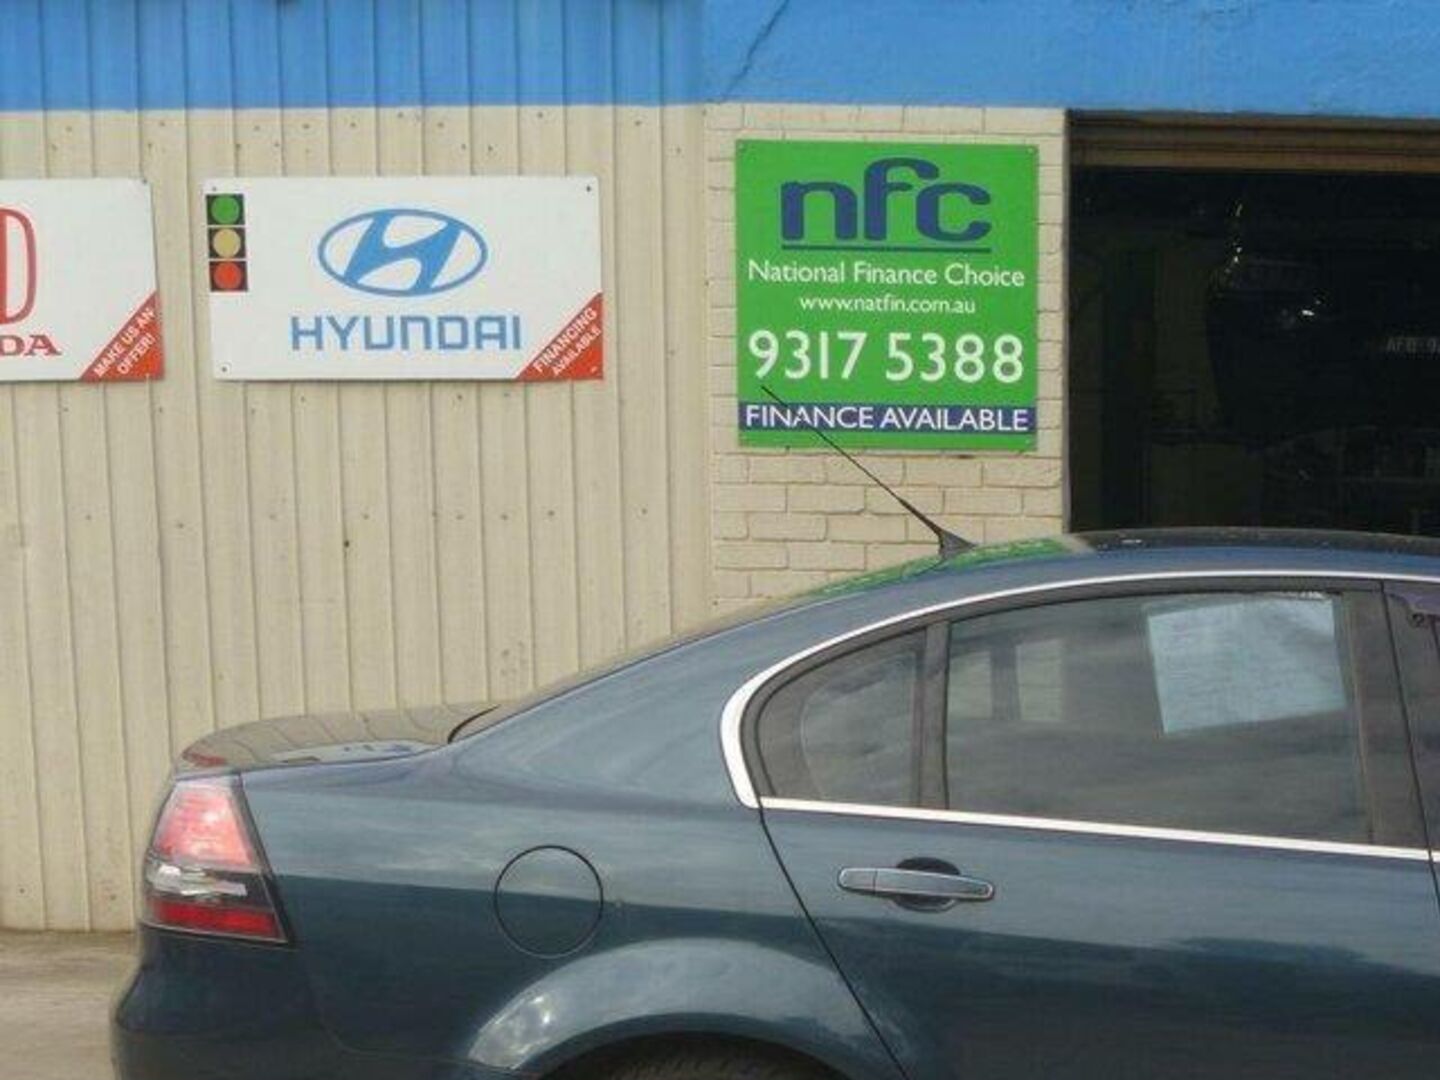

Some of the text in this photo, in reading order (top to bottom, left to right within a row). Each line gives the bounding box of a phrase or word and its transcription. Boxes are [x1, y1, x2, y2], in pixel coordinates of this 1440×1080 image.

[781, 156, 992, 243] nfc
[748, 259, 1025, 287] National Finance Choice
[800, 293, 977, 315] www.natfin.com.au
[94, 342, 128, 377] MAKE
[121, 326, 140, 345] US
[291, 314, 522, 351] HYUNDAI
[532, 307, 598, 373] FINANCING
[551, 324, 602, 376] AVAILABLE
[748, 329, 1024, 384] 9317 5388
[746, 404, 1029, 432] FINANCE AVAILABLE
